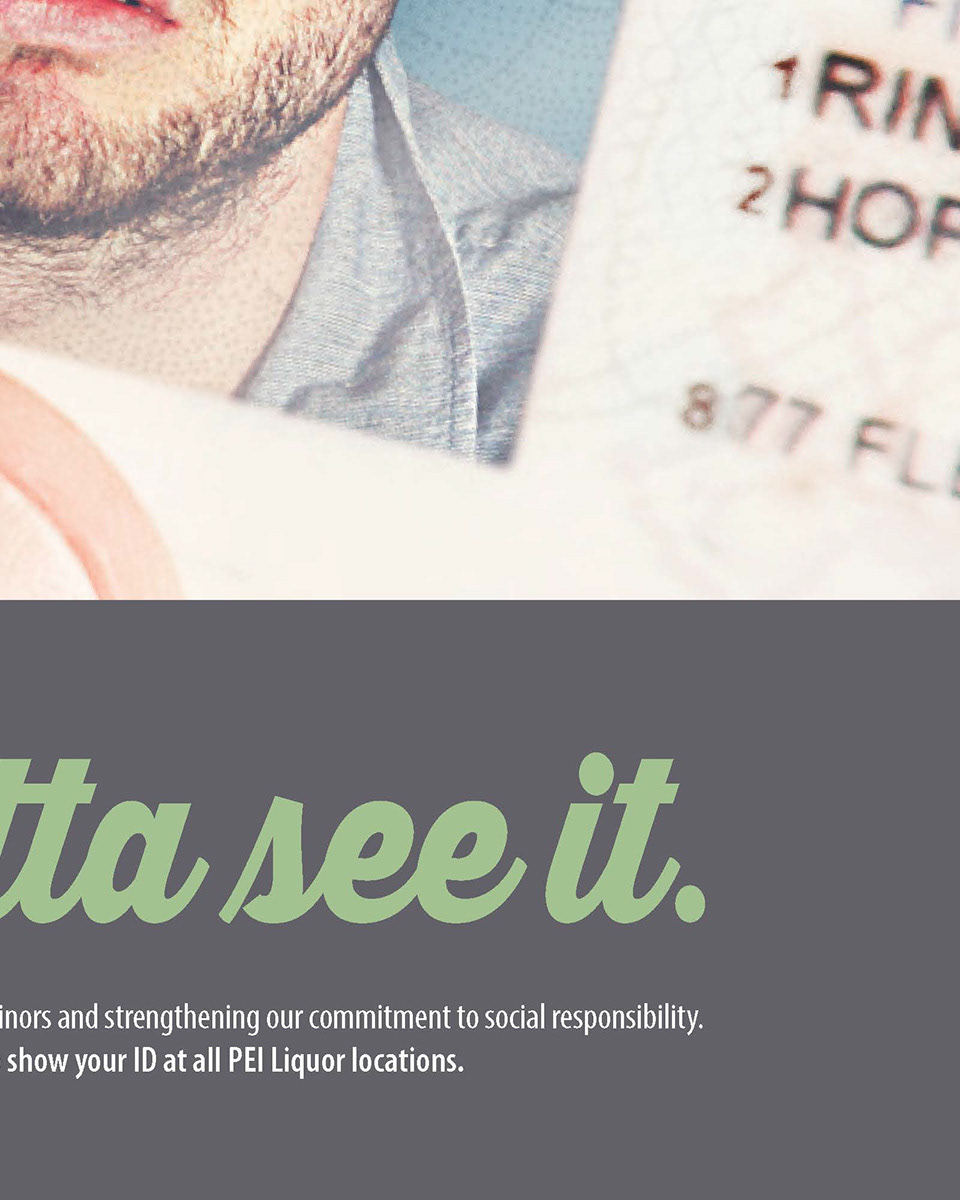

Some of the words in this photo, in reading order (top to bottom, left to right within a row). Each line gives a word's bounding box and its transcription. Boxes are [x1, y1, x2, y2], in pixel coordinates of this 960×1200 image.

[737, 164, 774, 215] 2
[681, 383, 717, 432] 8
[734, 383, 824, 455] 77
[847, 416, 960, 498] FL
[219, 795, 528, 924] see
[545, 752, 706, 924] it.
[58, 1003, 98, 1030] and
[105, 1003, 260, 1036] strengthening
[266, 1009, 304, 1030] our
[309, 1004, 451, 1030] commitment
[457, 1005, 479, 1030] to
[485, 1003, 545, 1030] social
[552, 1003, 704, 1036] responsibility.
[8, 1046, 70, 1073] show
[75, 1053, 128, 1080] your
[134, 1047, 157, 1073] ID
[163, 1049, 187, 1073] at
[193, 1046, 221, 1073] all
[229, 1047, 263, 1073] PEI
[271, 1047, 346, 1080] Liquor
[352, 1046, 464, 1073] locations.
